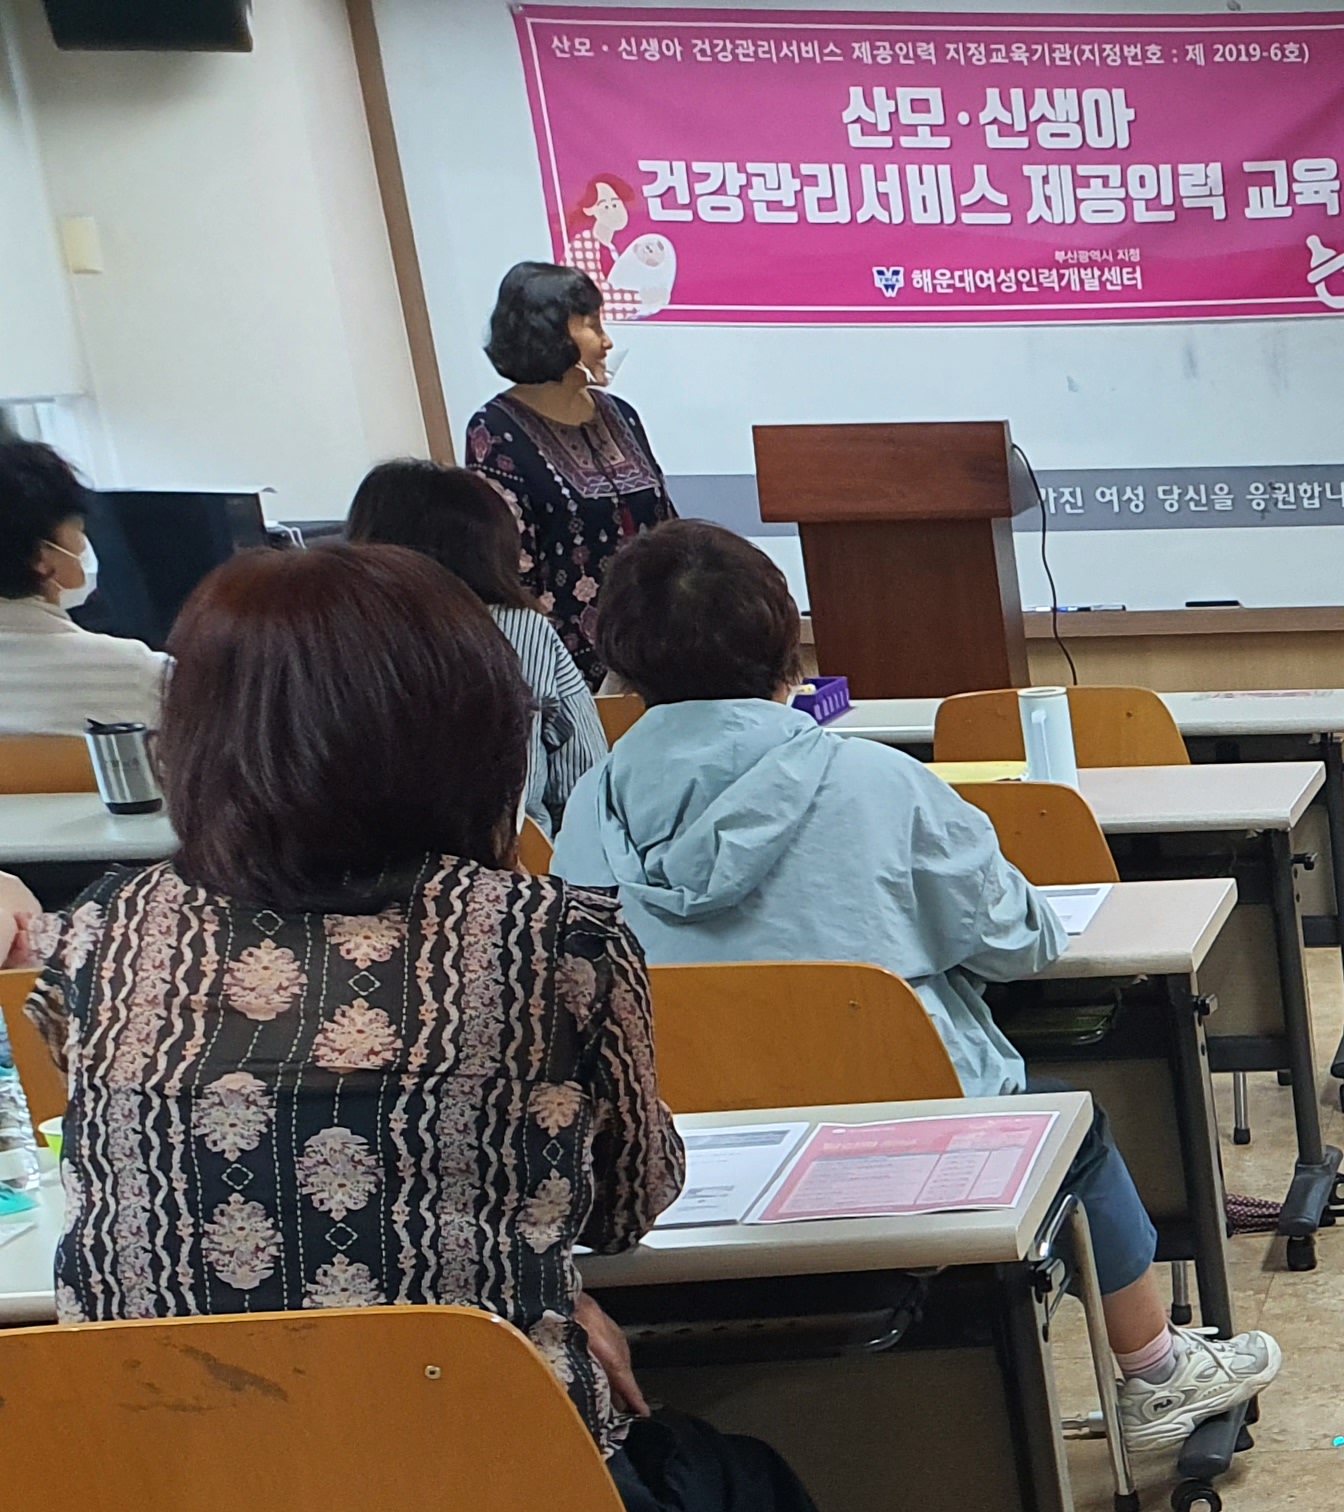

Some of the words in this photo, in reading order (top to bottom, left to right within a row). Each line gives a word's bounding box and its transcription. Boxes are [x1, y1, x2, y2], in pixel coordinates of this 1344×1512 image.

[551, 36, 594, 59] 산모
[617, 38, 683, 62] 신생아
[692, 39, 844, 64] 건강관리서비스
[851, 41, 937, 66] 제공인력
[1185, 43, 1206, 66] 제
[1213, 42, 1310, 65] 2019-6호)
[637, 158, 1012, 225] 건강관리서비스
[1022, 160, 1228, 225] 제공인력
[1242, 157, 1341, 219] 교육
[1055, 249, 1114, 264] 부산광역시
[911, 265, 1143, 293] 해운대여성인력개발센터
[1095, 485, 1145, 514] 여성
[1157, 482, 1234, 512] 당신을
